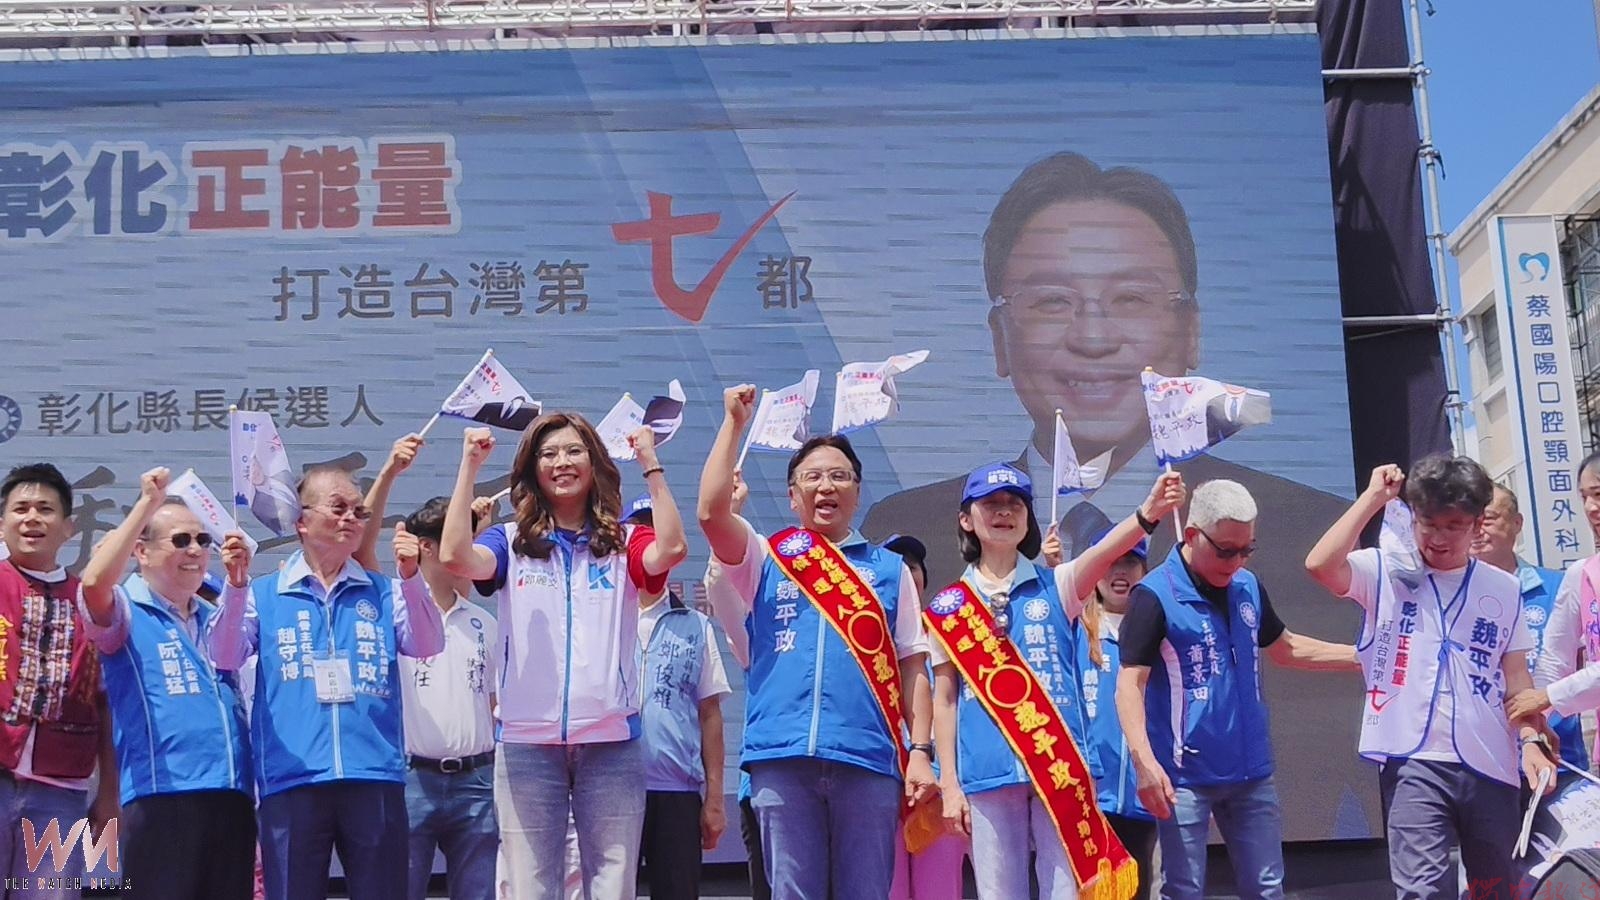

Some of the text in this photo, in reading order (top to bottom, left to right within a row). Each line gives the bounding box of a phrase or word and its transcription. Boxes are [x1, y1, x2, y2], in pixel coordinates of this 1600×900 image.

[0, 141, 456, 239] 彰化正能量
[38, 384, 384, 436] 彰化縣長候選人
[1525, 294, 1581, 571] 蔡國陽口腔顎面外科
[589, 562, 616, 590] K
[355, 620, 378, 683] 魏平政
[774, 580, 799, 653] 魏平政
[1391, 601, 1418, 687] 彰化正能量
[277, 627, 300, 682] 趙守博
[653, 639, 680, 711] 鄭俊雄
[1024, 624, 1053, 692] 魏平政
[1468, 616, 1499, 705] 魏平政
[1012, 700, 1081, 791] 魏平政
